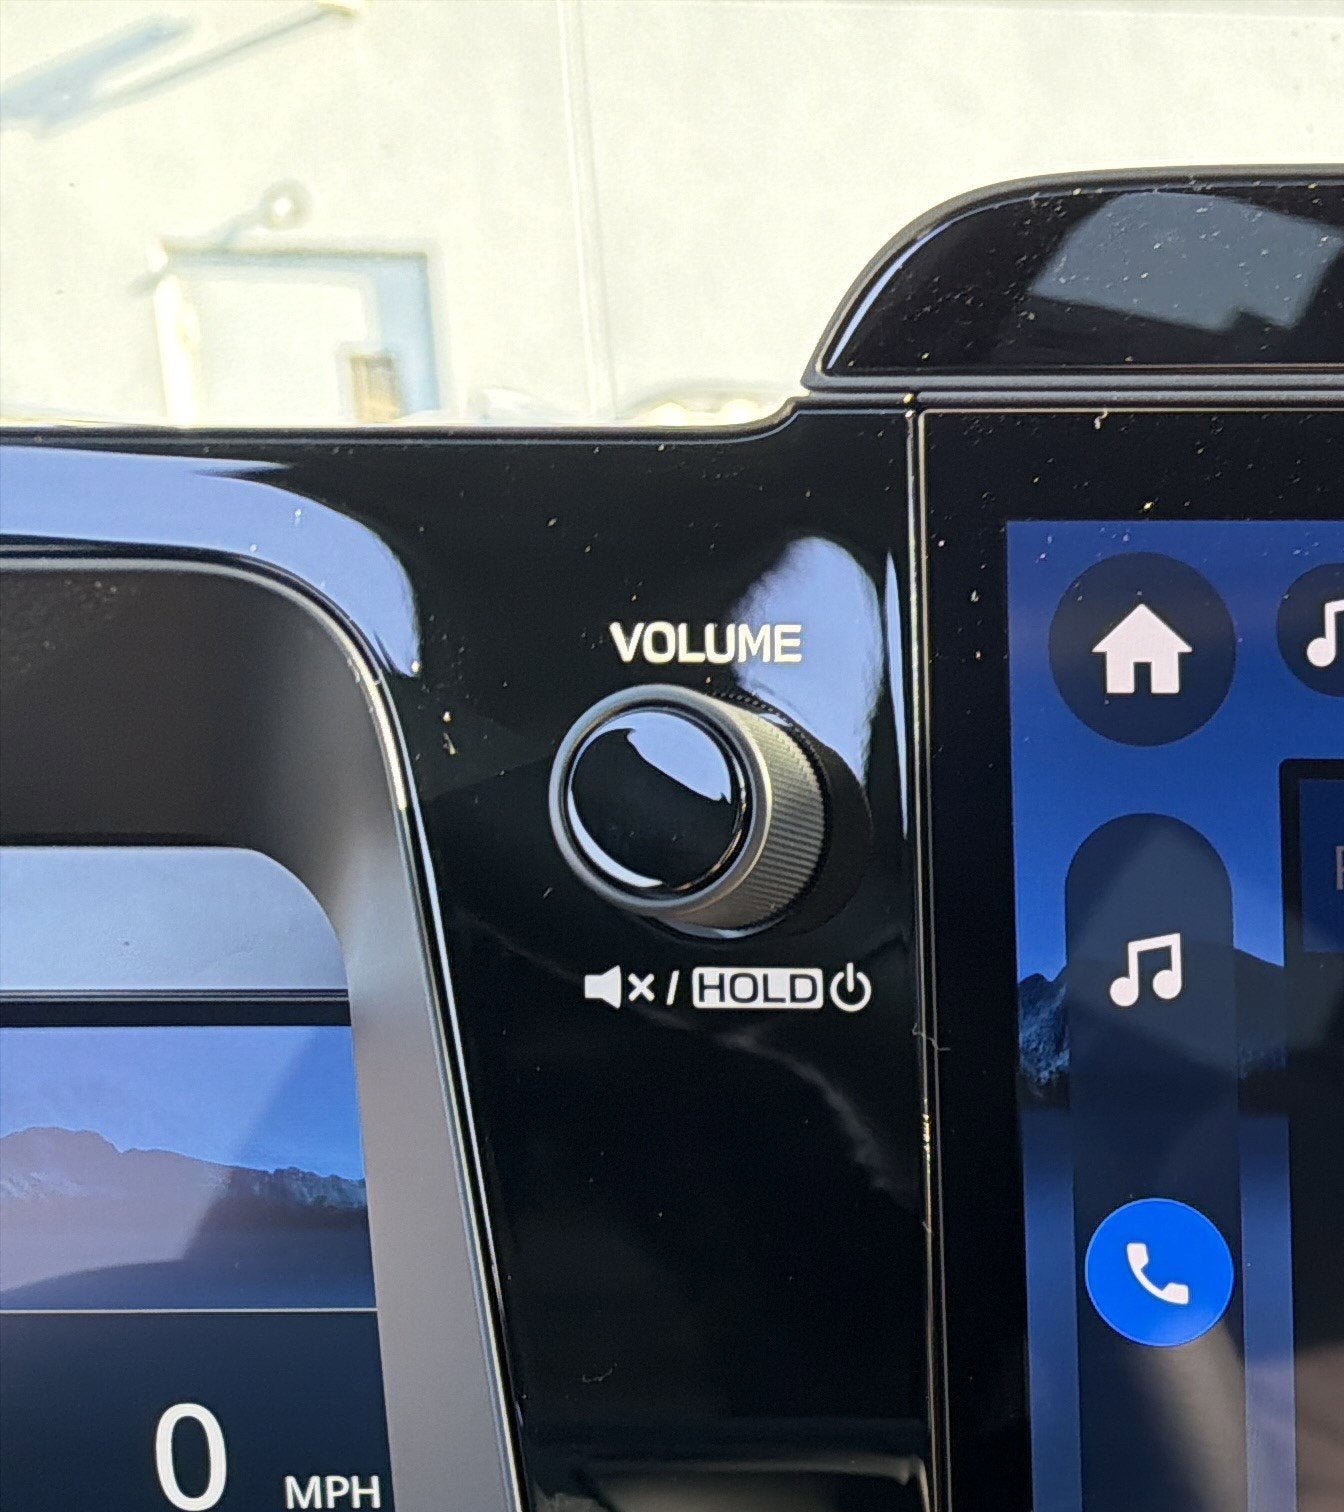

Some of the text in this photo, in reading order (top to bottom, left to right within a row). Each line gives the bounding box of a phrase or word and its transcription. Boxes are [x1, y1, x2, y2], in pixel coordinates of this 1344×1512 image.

[609, 620, 804, 664] VOLUME
[696, 970, 819, 1005] HOLD
[155, 1403, 228, 1511] 0
[285, 1475, 381, 1509] MPH
